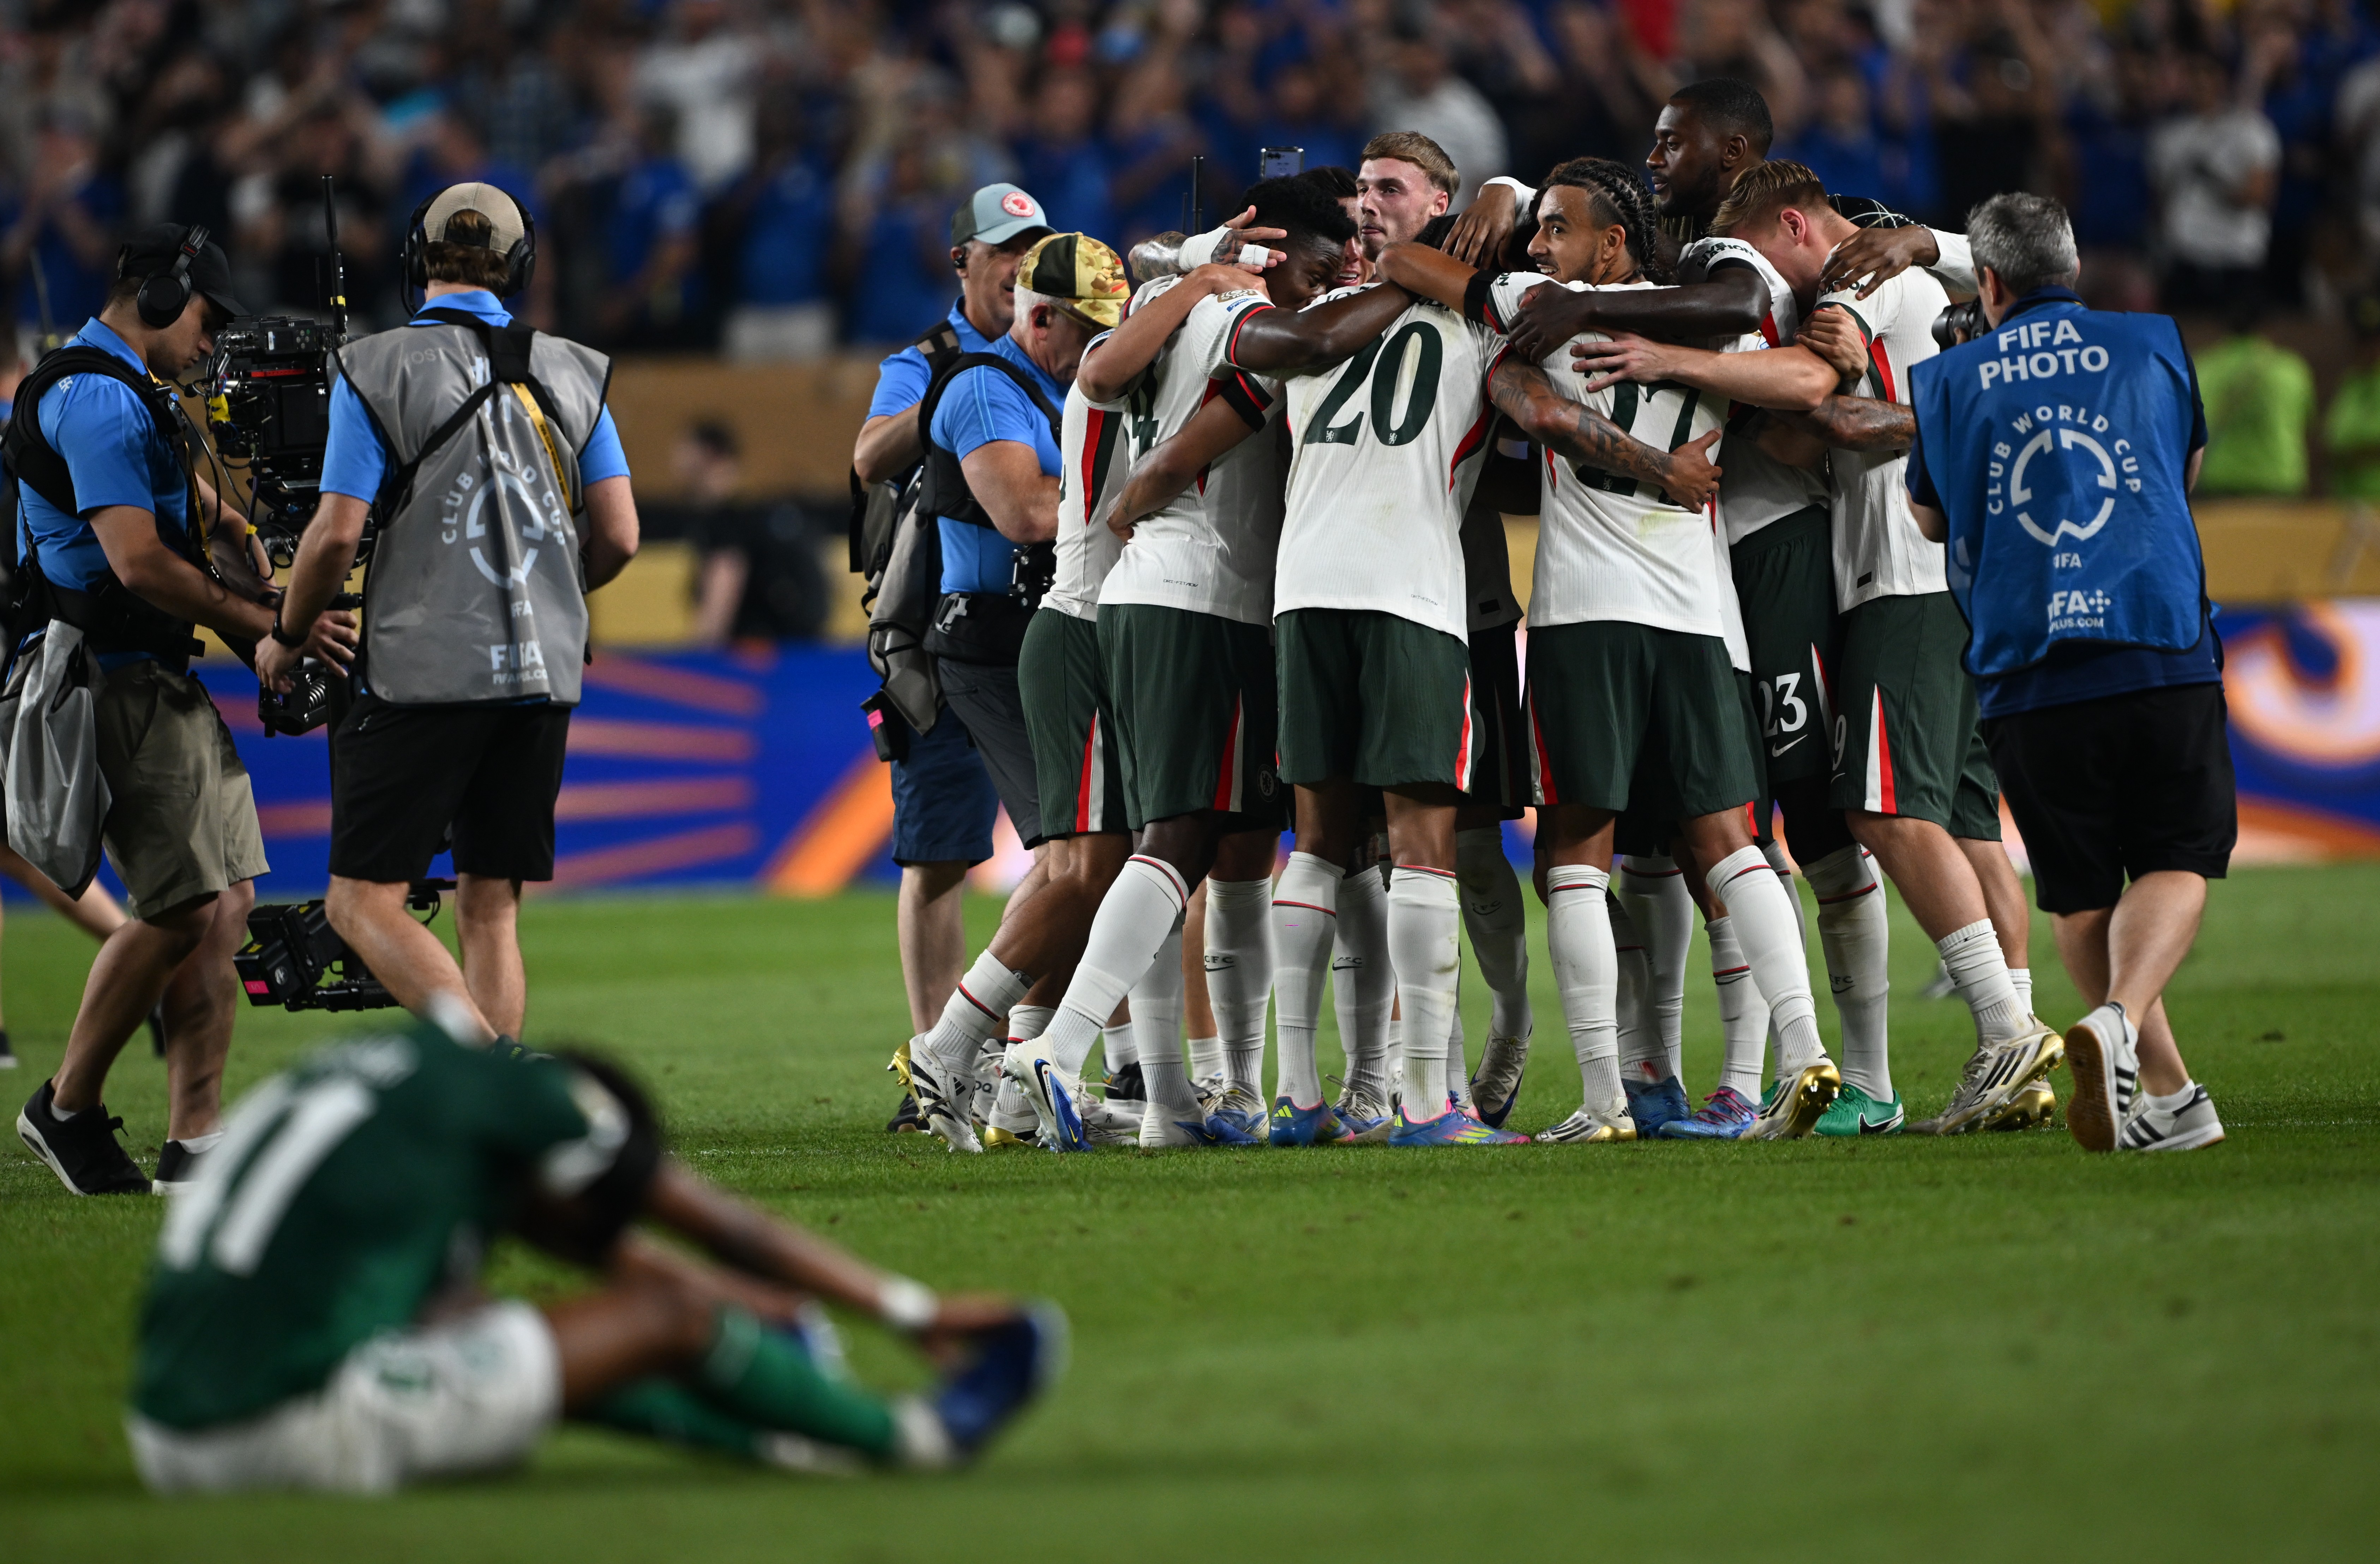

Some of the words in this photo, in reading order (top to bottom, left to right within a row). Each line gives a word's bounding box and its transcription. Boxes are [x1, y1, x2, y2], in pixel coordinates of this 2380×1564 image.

[1979, 345, 2109, 390] PHOTO
[1999, 319, 2083, 352] FIFA
[1305, 320, 1443, 446] 20
[1988, 441, 2011, 515] CLUB
[2012, 404, 2109, 433] WORLD
[2114, 438, 2141, 493] CUP
[441, 471, 474, 544] CLUB
[542, 490, 566, 546] CUP
[2053, 552, 2082, 569] IFA
[1758, 672, 1808, 736] 23
[1204, 955, 1234, 963] CFC
[159, 1069, 378, 1279] 11
